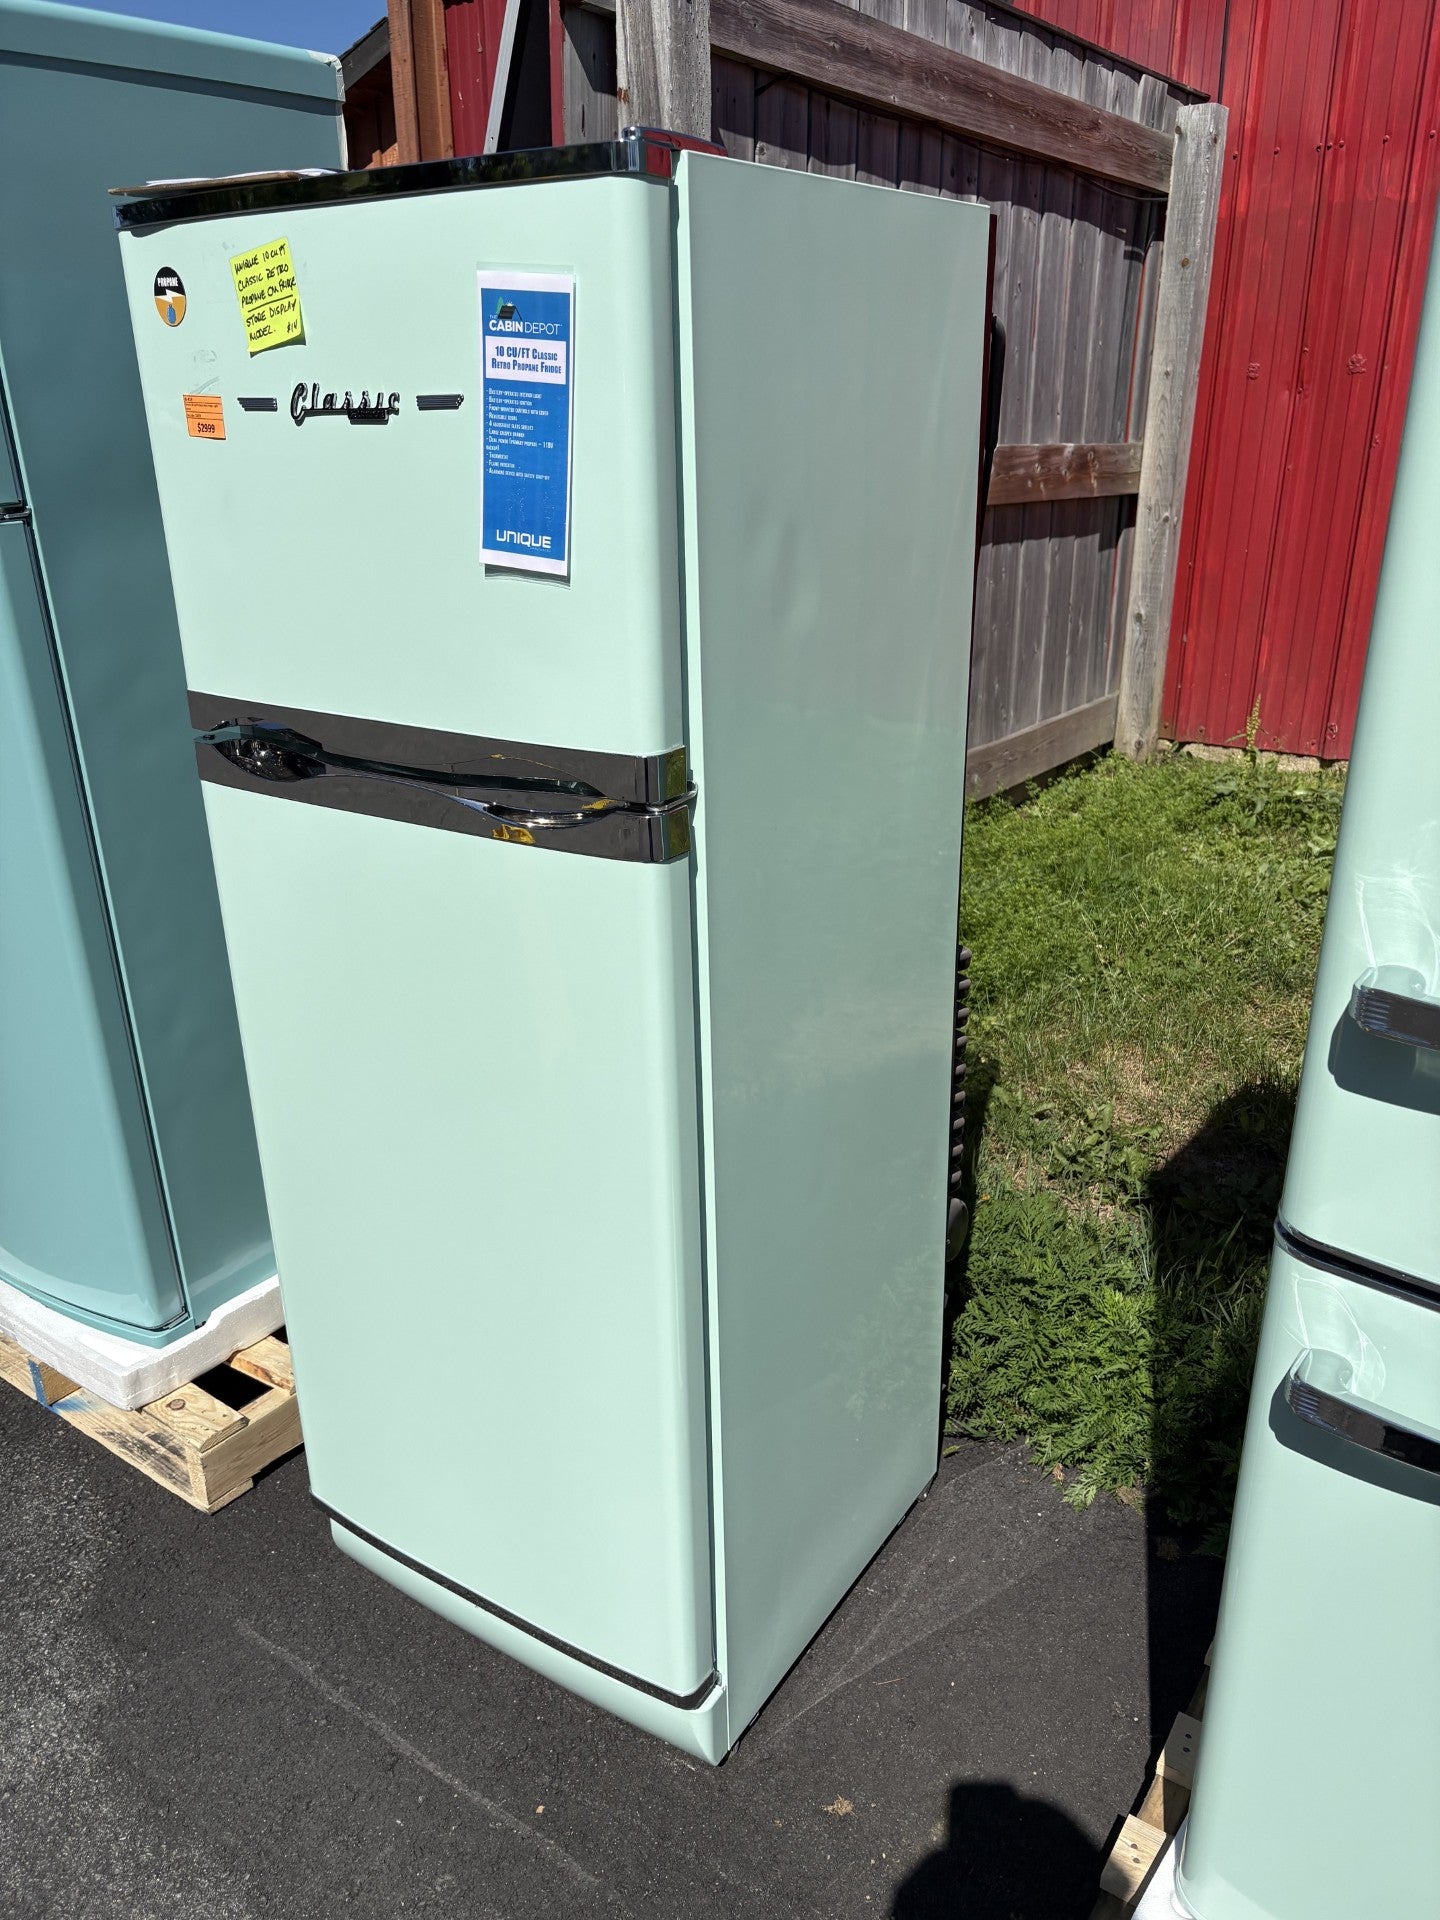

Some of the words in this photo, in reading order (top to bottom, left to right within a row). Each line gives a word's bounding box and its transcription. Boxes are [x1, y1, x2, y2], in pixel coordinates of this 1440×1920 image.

[235, 254, 259, 275] UNIQUE
[262, 251, 269, 262] 10
[158, 277, 178, 287] PROPANE
[238, 273, 263, 292] CLASSIC
[266, 264, 289, 280] RETRO
[242, 290, 266, 308] PROPANE
[246, 311, 266, 328] STORE
[269, 298, 296, 318] DISPLAY
[495, 346, 504, 357] 10
[507, 346, 530, 358] CU/FT
[532, 348, 558, 361] CLASSIC
[492, 358, 510, 369] RETRO
[513, 360, 538, 372] PROPANE
[540, 362, 561, 374] FRIDGE
[290, 382, 400, 422] Classic
[197, 422, 215, 433] $2999
[496, 529, 552, 548] UNIQUE
